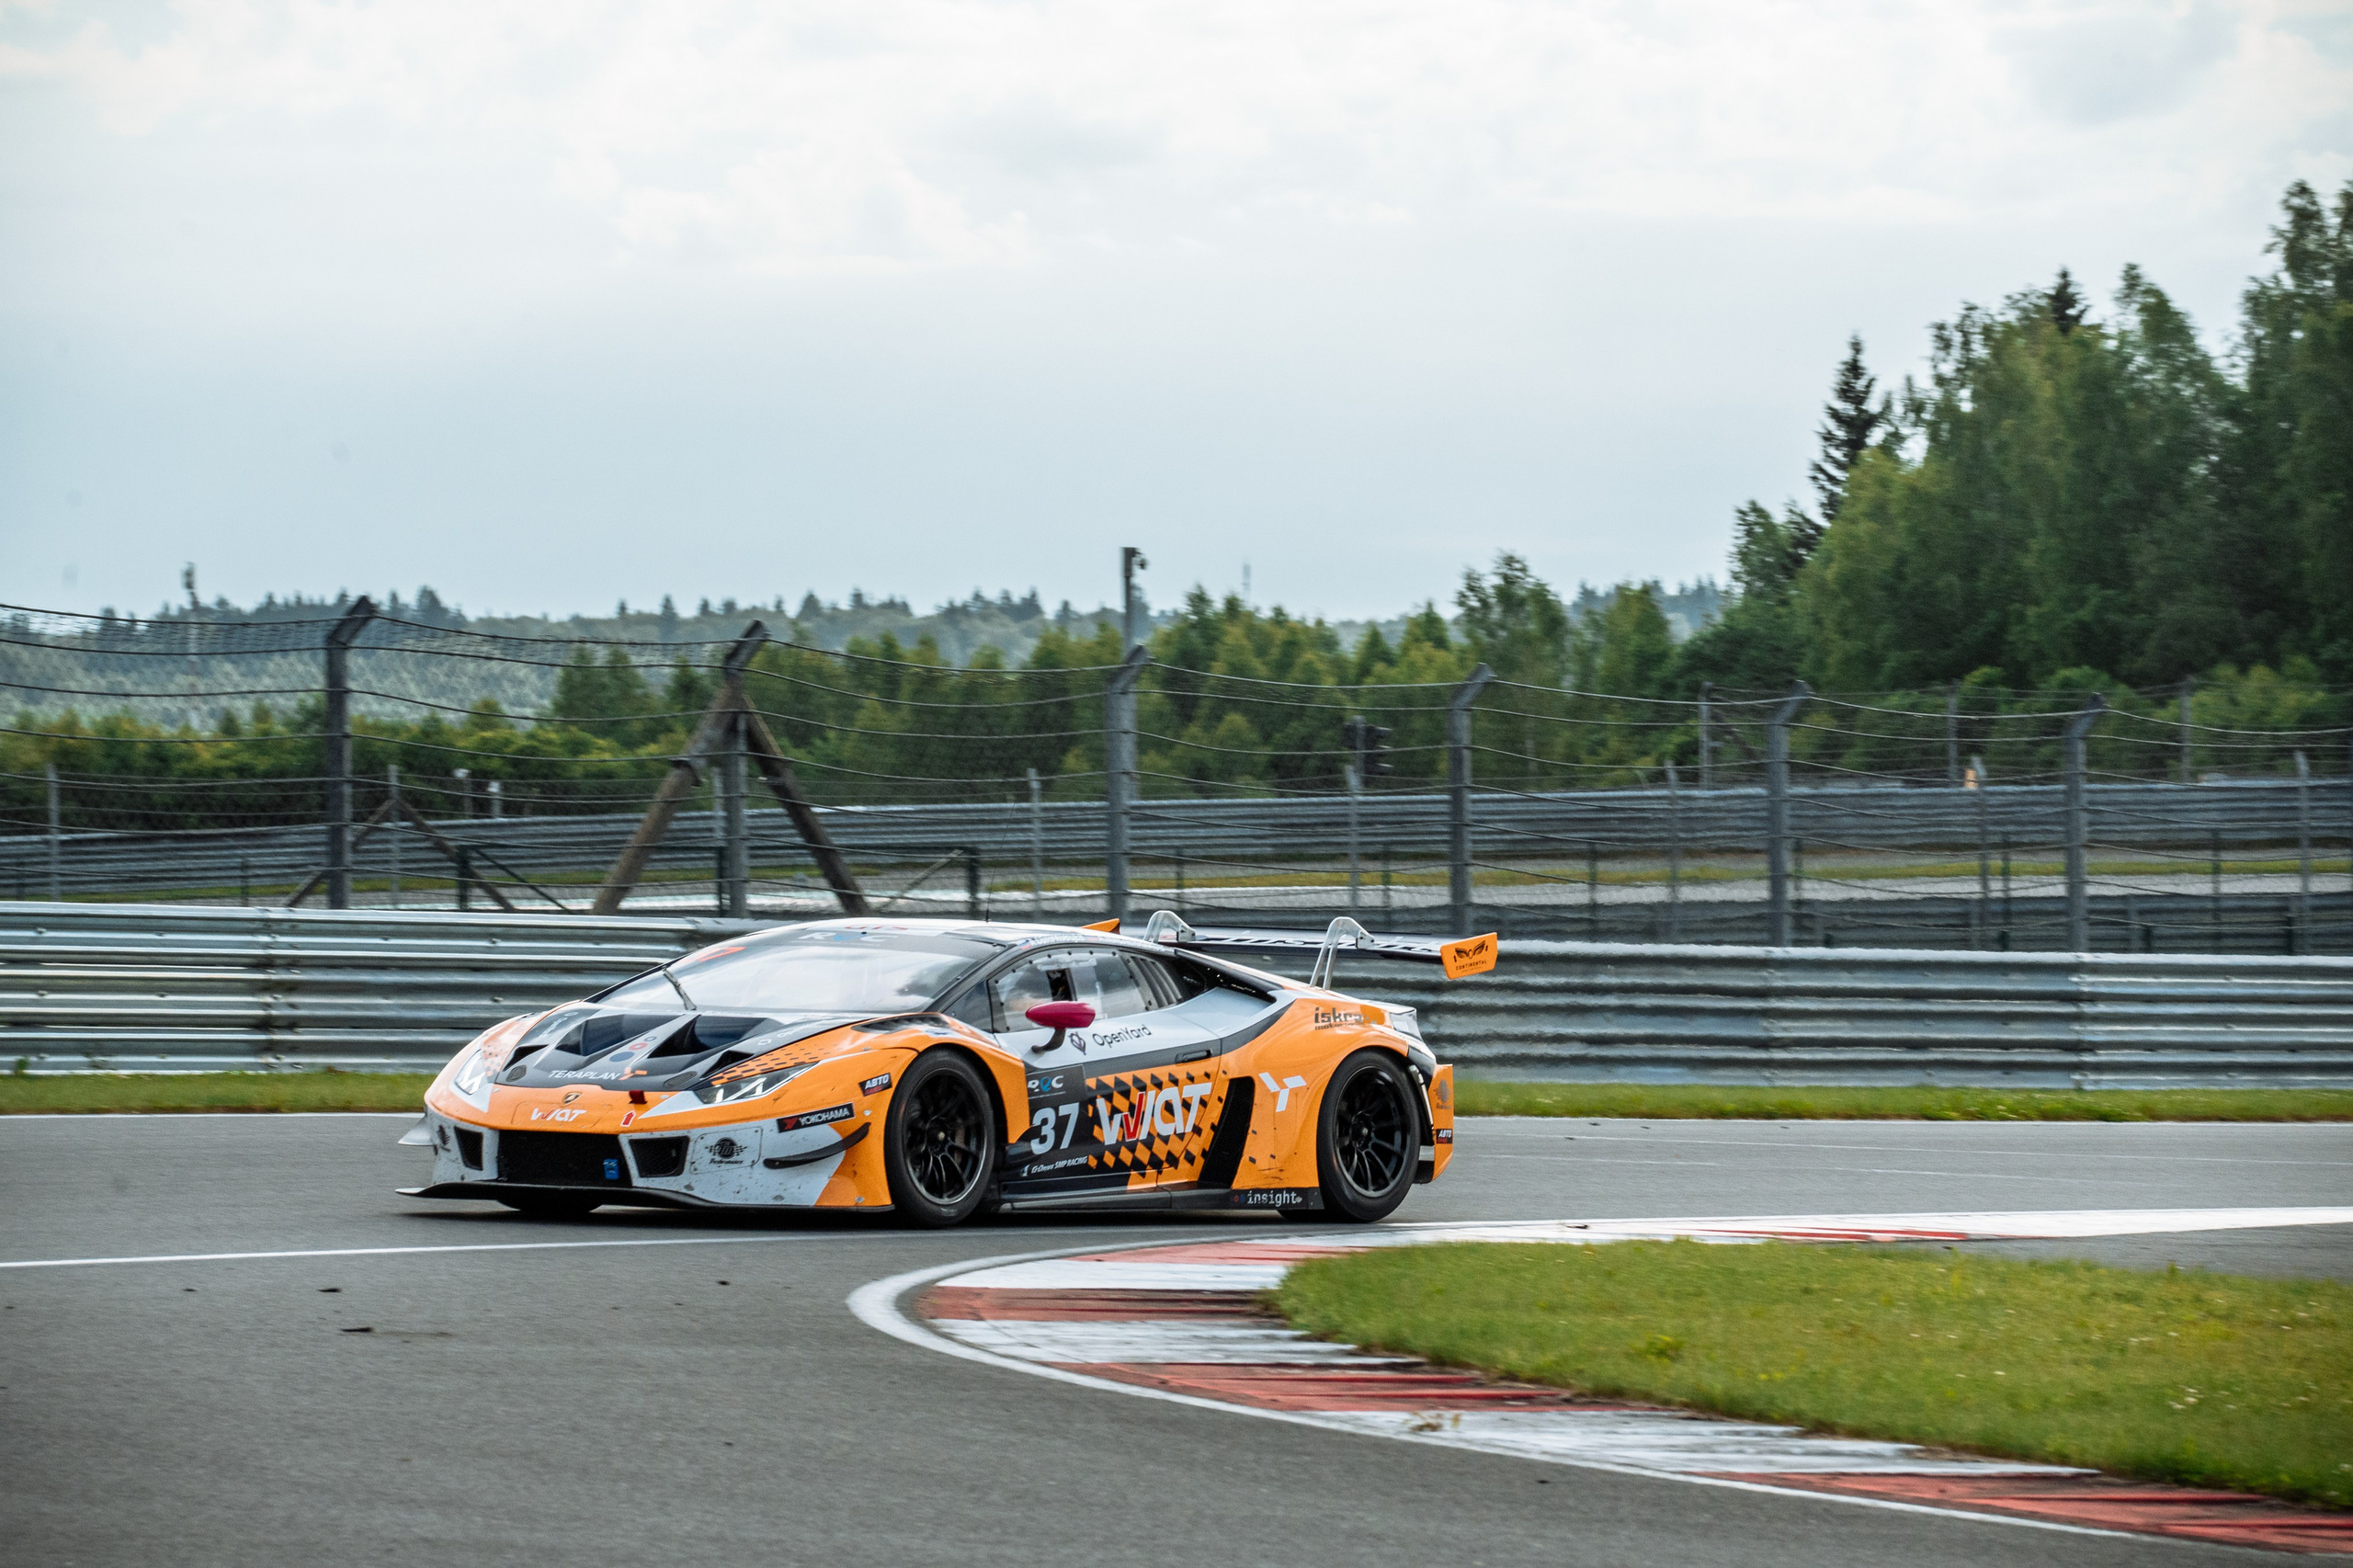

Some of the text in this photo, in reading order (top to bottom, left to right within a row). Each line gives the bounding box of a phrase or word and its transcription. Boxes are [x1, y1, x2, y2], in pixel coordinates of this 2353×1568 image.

[1092, 1024, 1153, 1049] OpenYard
[549, 1070, 621, 1081] TERAPLAN
[799, 1107, 850, 1126] YOKOHAMA
[1030, 1102, 1080, 1154] 37
[1247, 1189, 1297, 1207] insight
